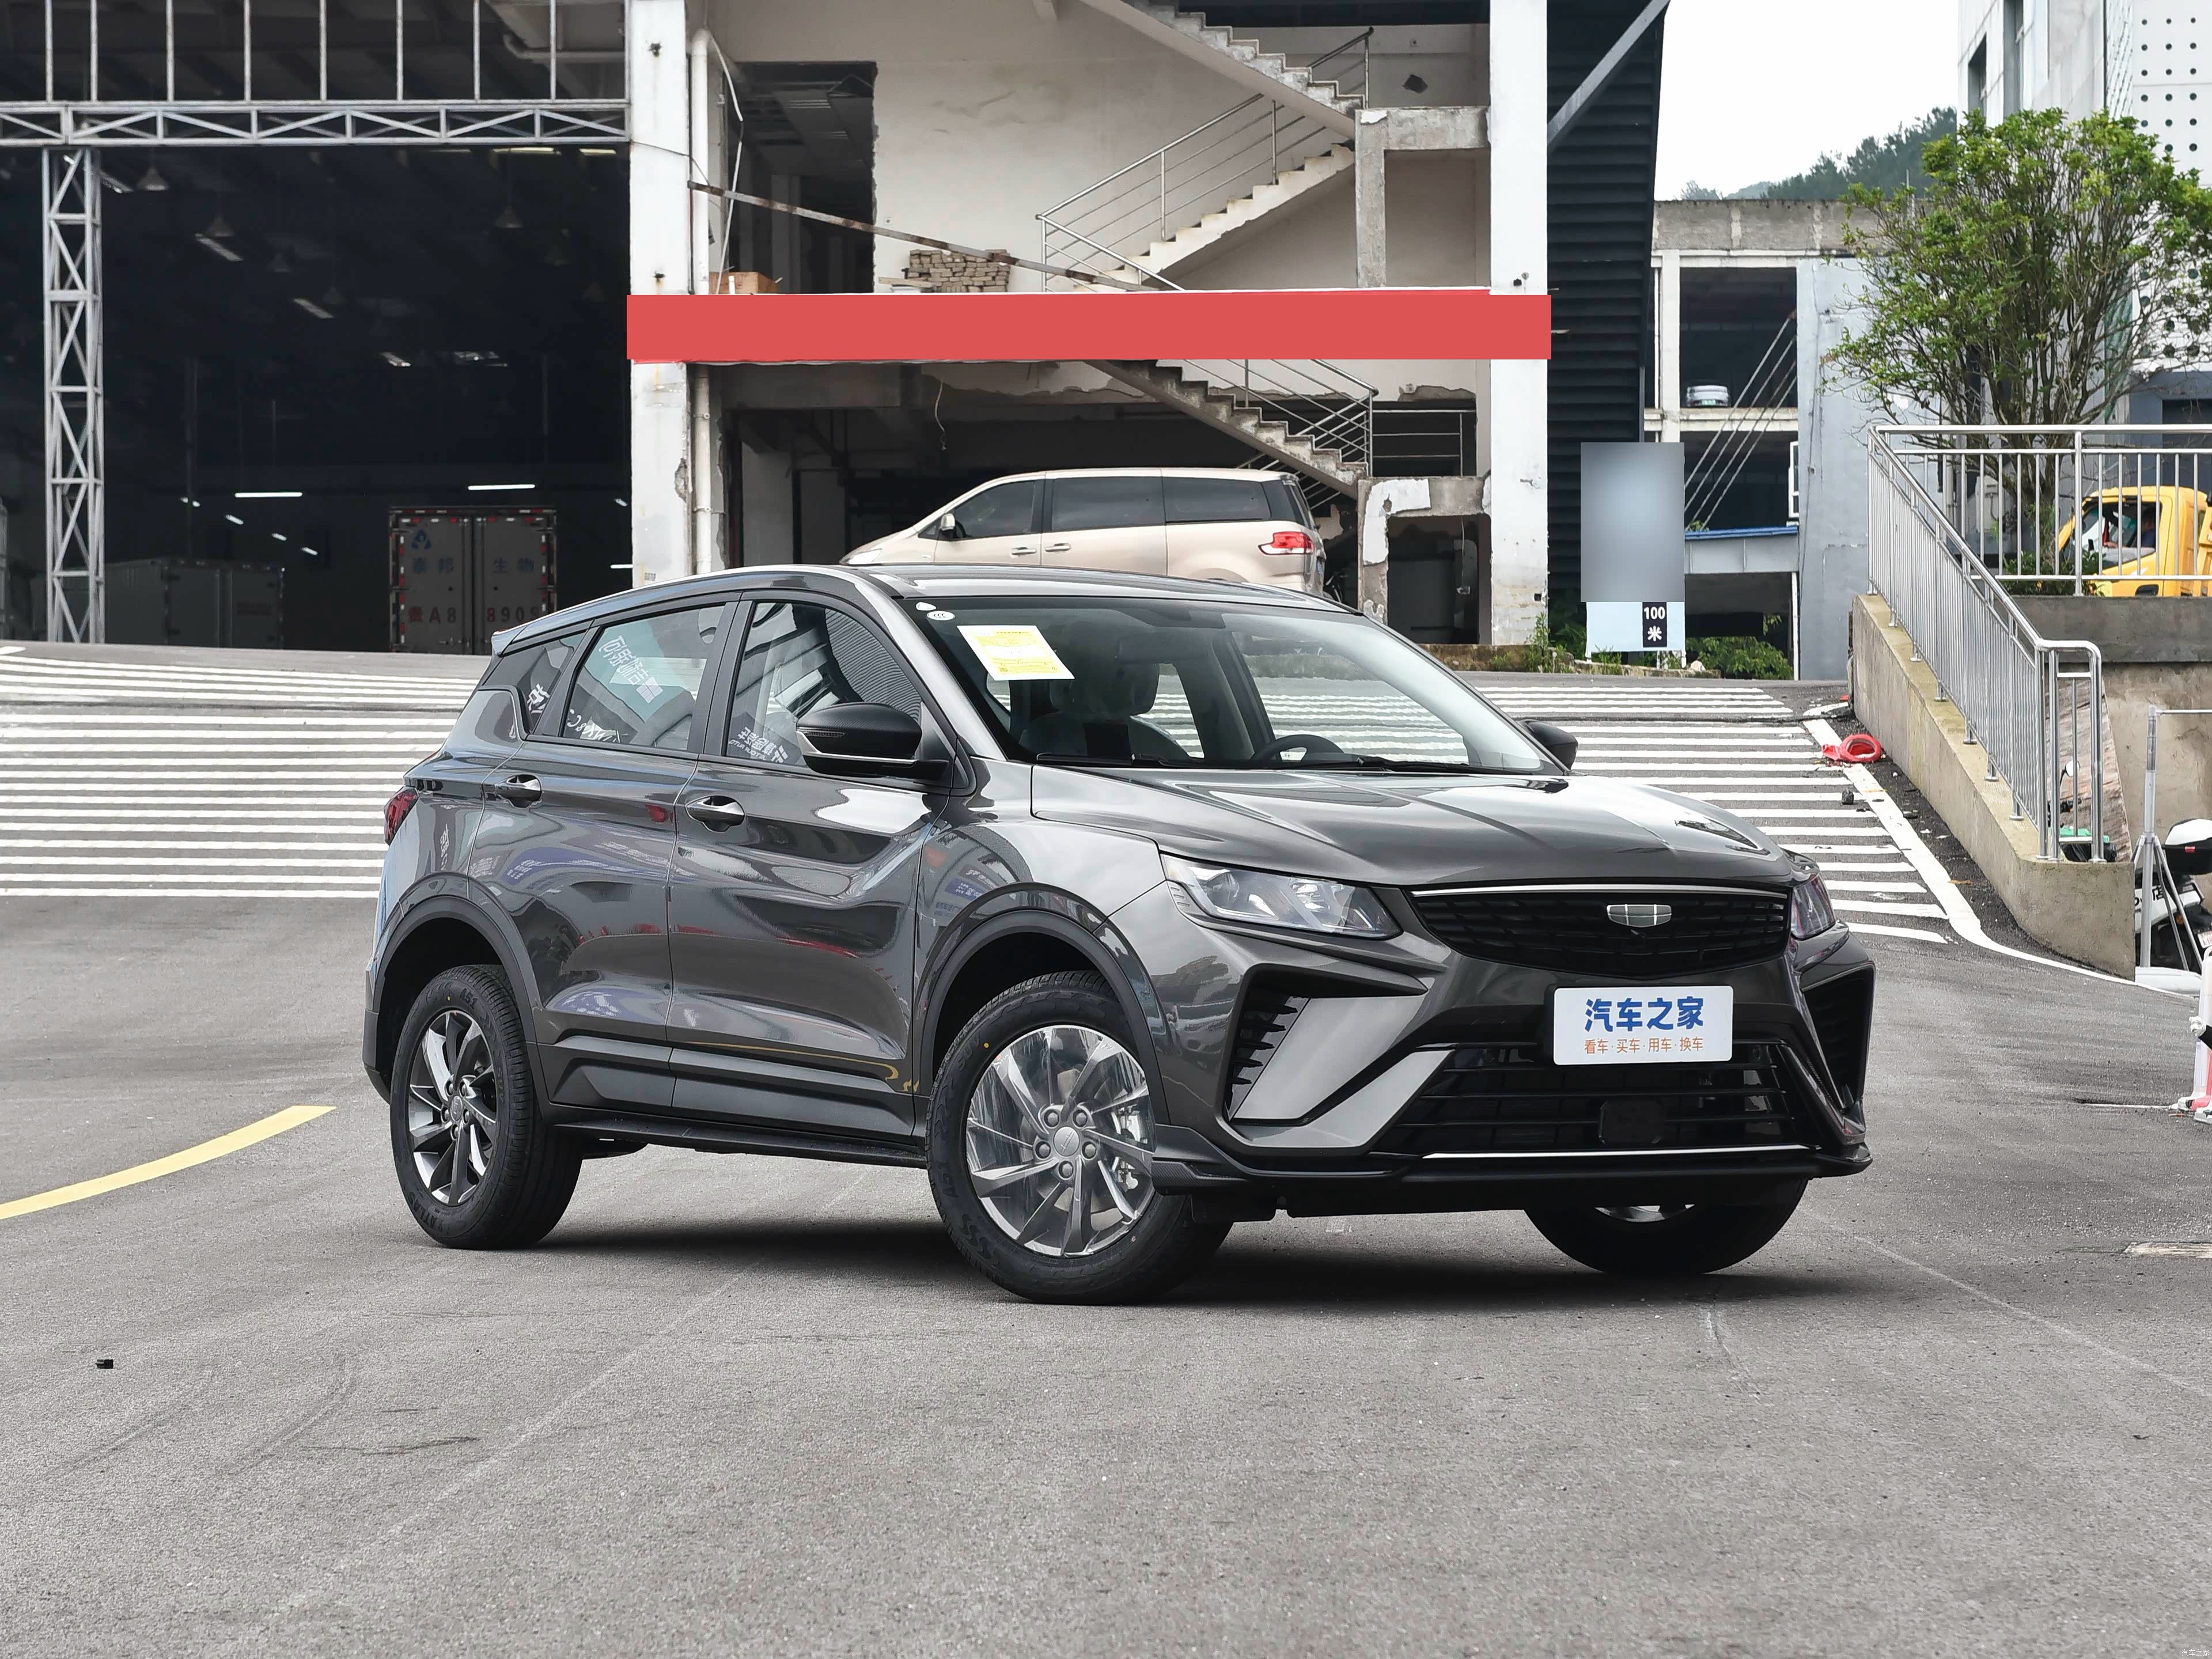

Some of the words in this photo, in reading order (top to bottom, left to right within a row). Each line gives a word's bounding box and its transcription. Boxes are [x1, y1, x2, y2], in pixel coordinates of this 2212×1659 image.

[1644, 607, 1665, 620] 100
[1647, 625, 1662, 642] 米
[1584, 996, 1704, 1032] 汽车之家
